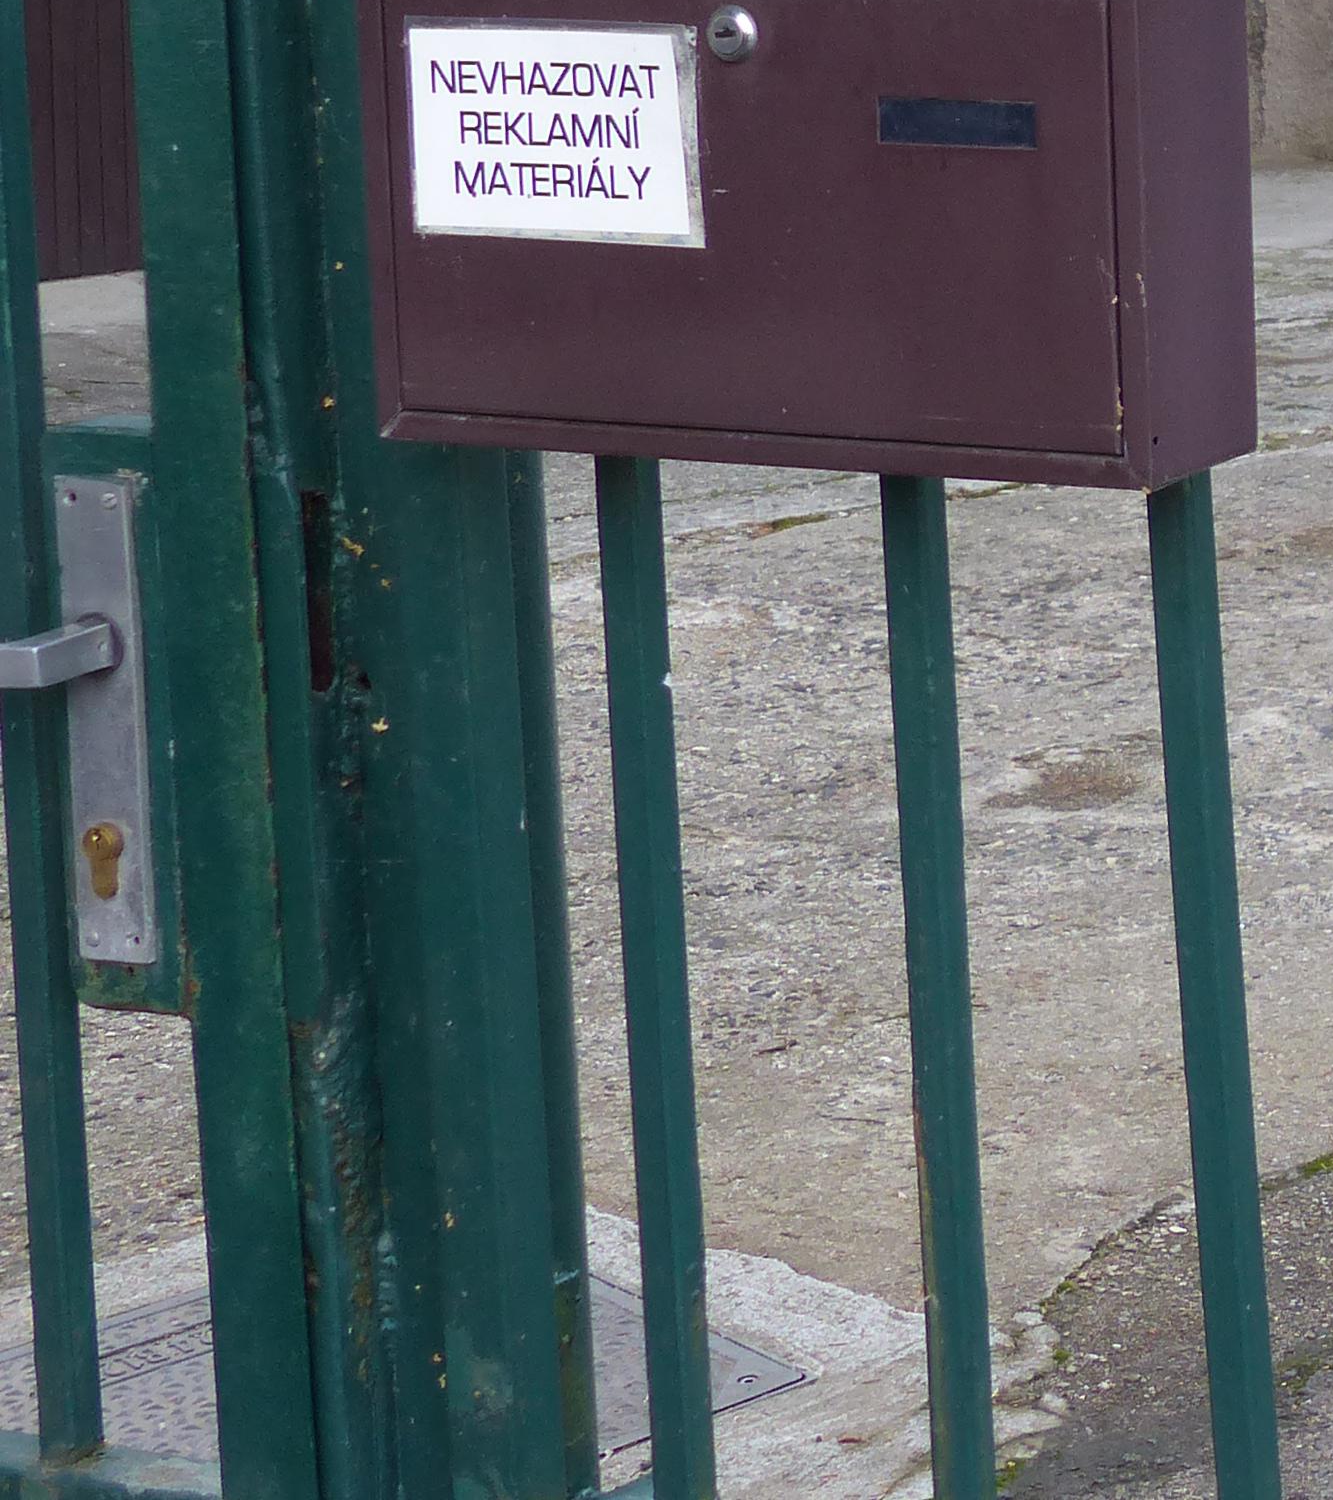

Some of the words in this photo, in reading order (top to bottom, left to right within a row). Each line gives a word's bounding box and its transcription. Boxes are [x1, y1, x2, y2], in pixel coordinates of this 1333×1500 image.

[431, 60, 660, 99] NEVHAZOVAT
[460, 107, 639, 149] REKLAMNÍ
[454, 157, 650, 200] MATERIÁLY
